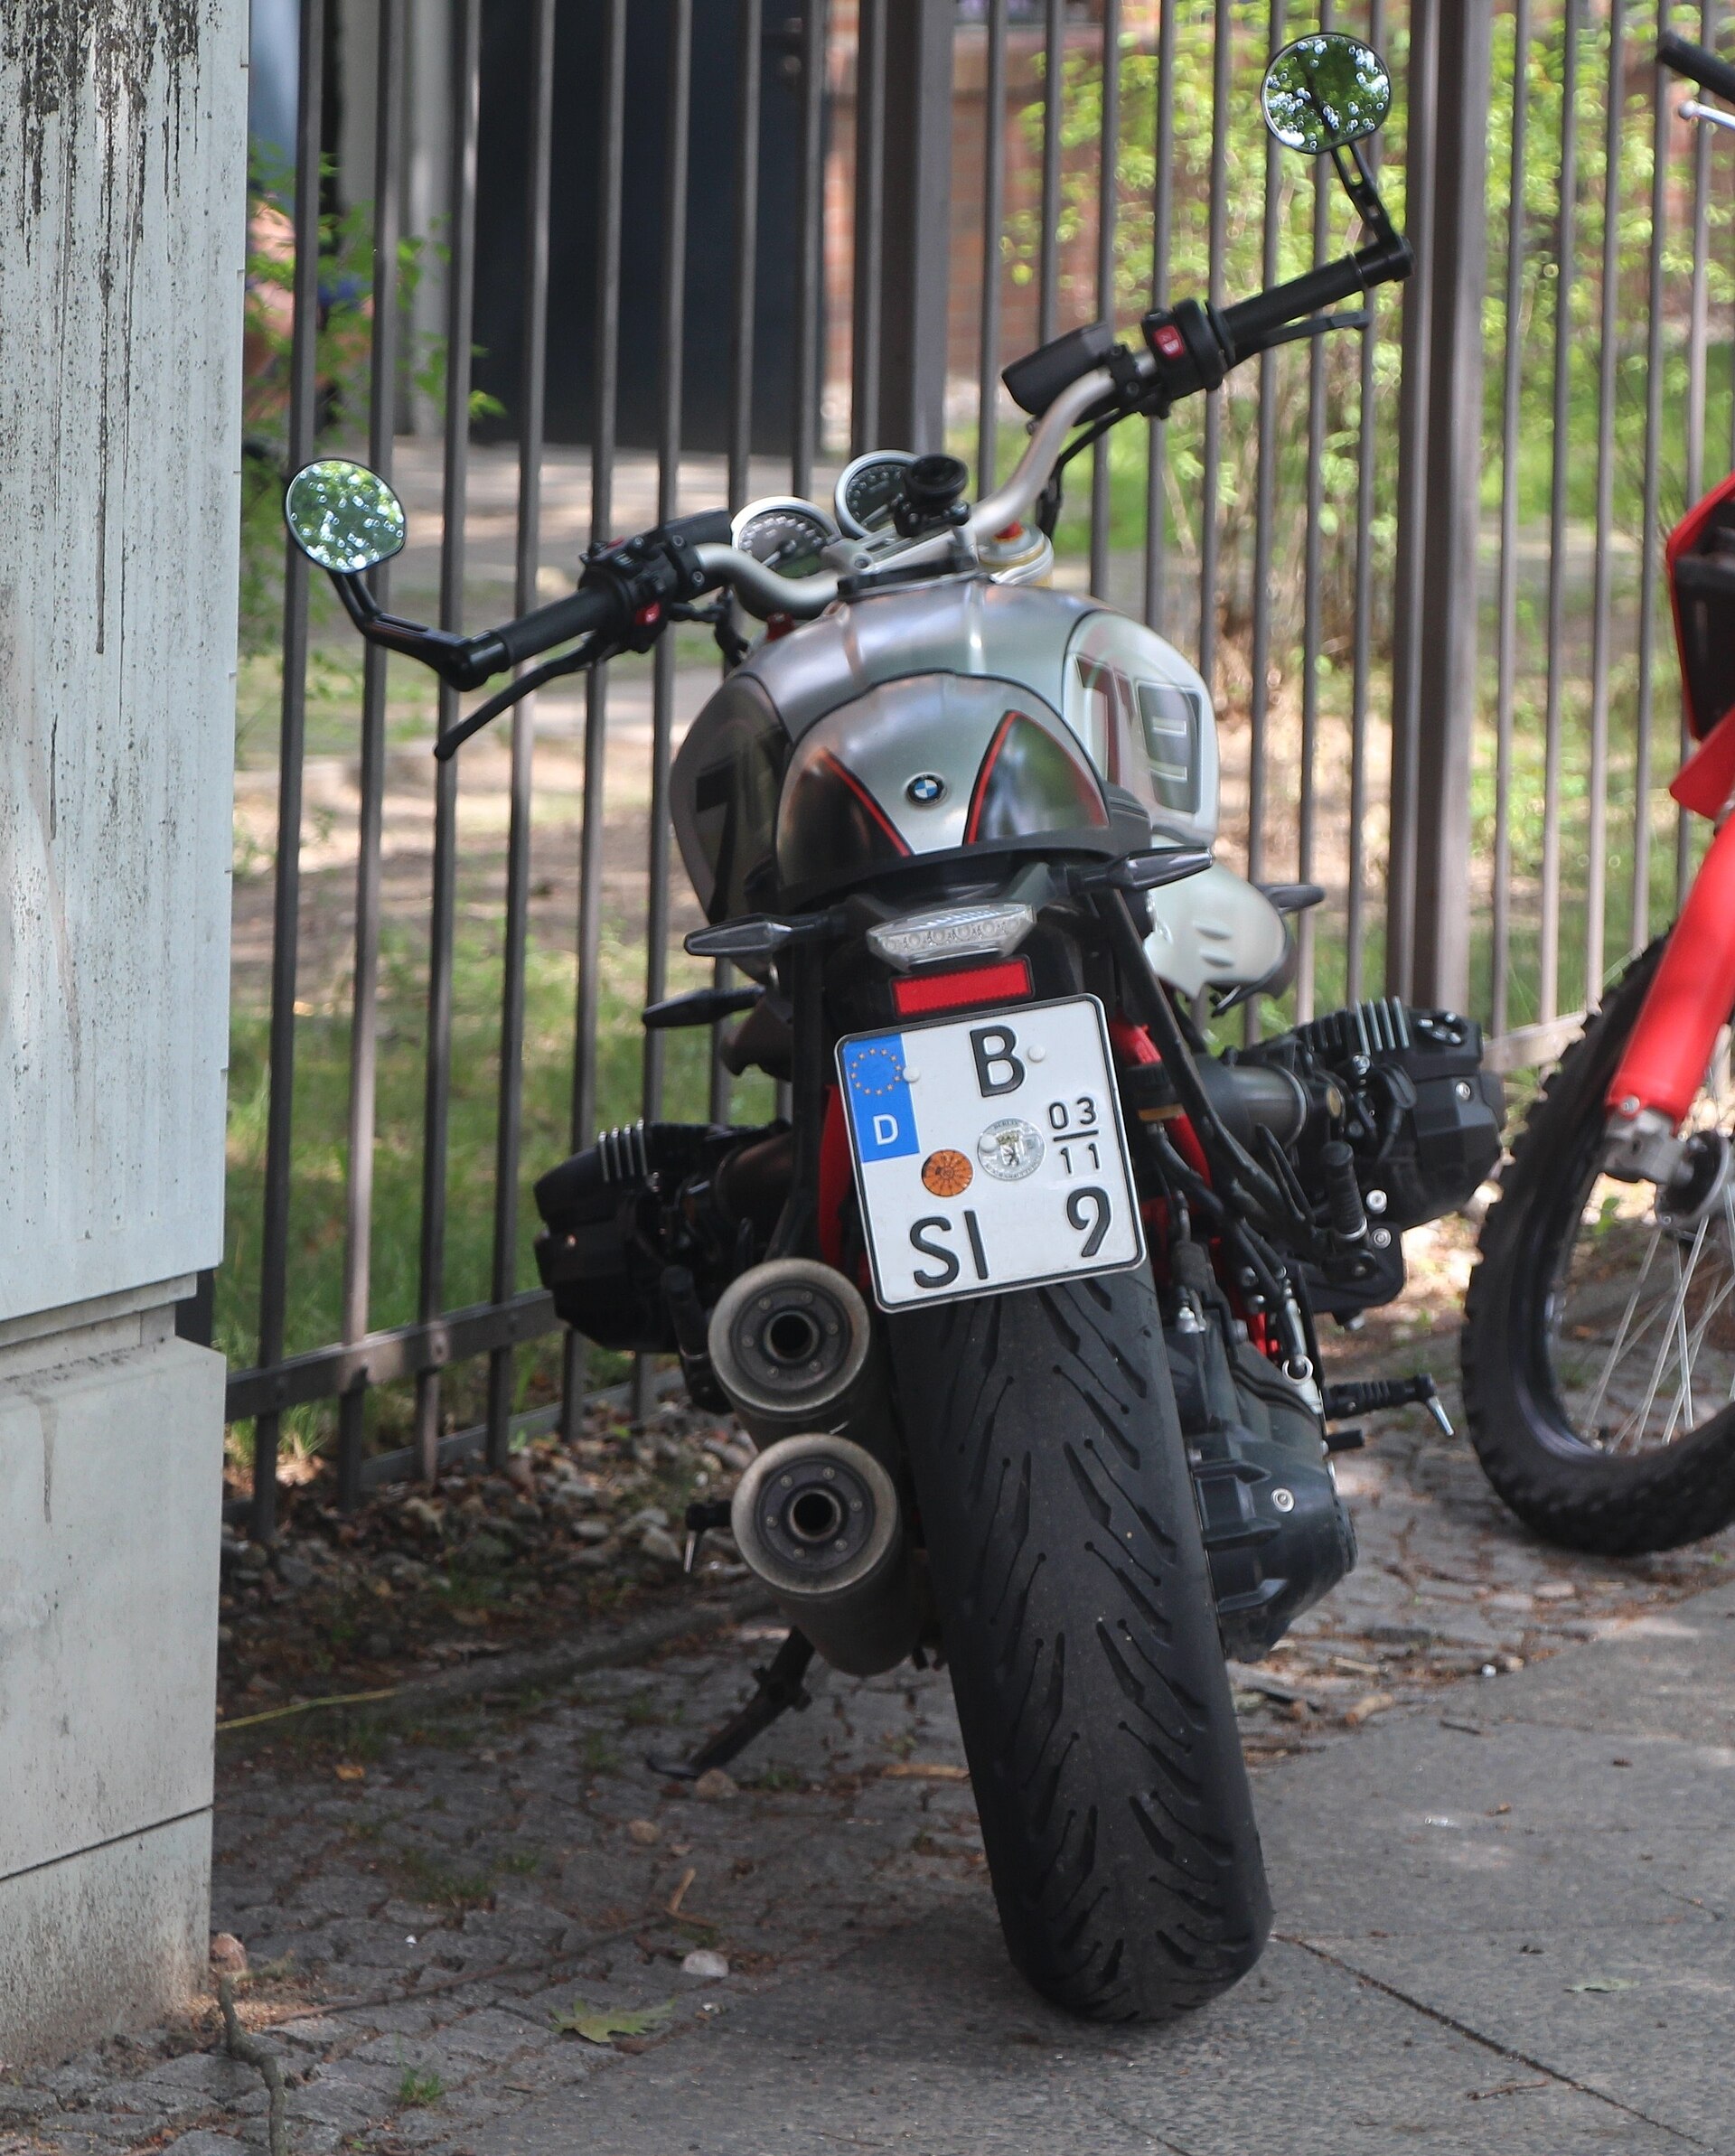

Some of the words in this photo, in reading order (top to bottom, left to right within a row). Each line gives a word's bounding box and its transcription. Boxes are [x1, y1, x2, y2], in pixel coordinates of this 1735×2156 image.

[970, 1025, 1026, 1098] B
[873, 1113, 899, 1146] D
[1048, 1096, 1098, 1130] 03
[1060, 1142, 1101, 1175] 11
[909, 1210, 989, 1289] SI
[1065, 1186, 1112, 1258] 9
